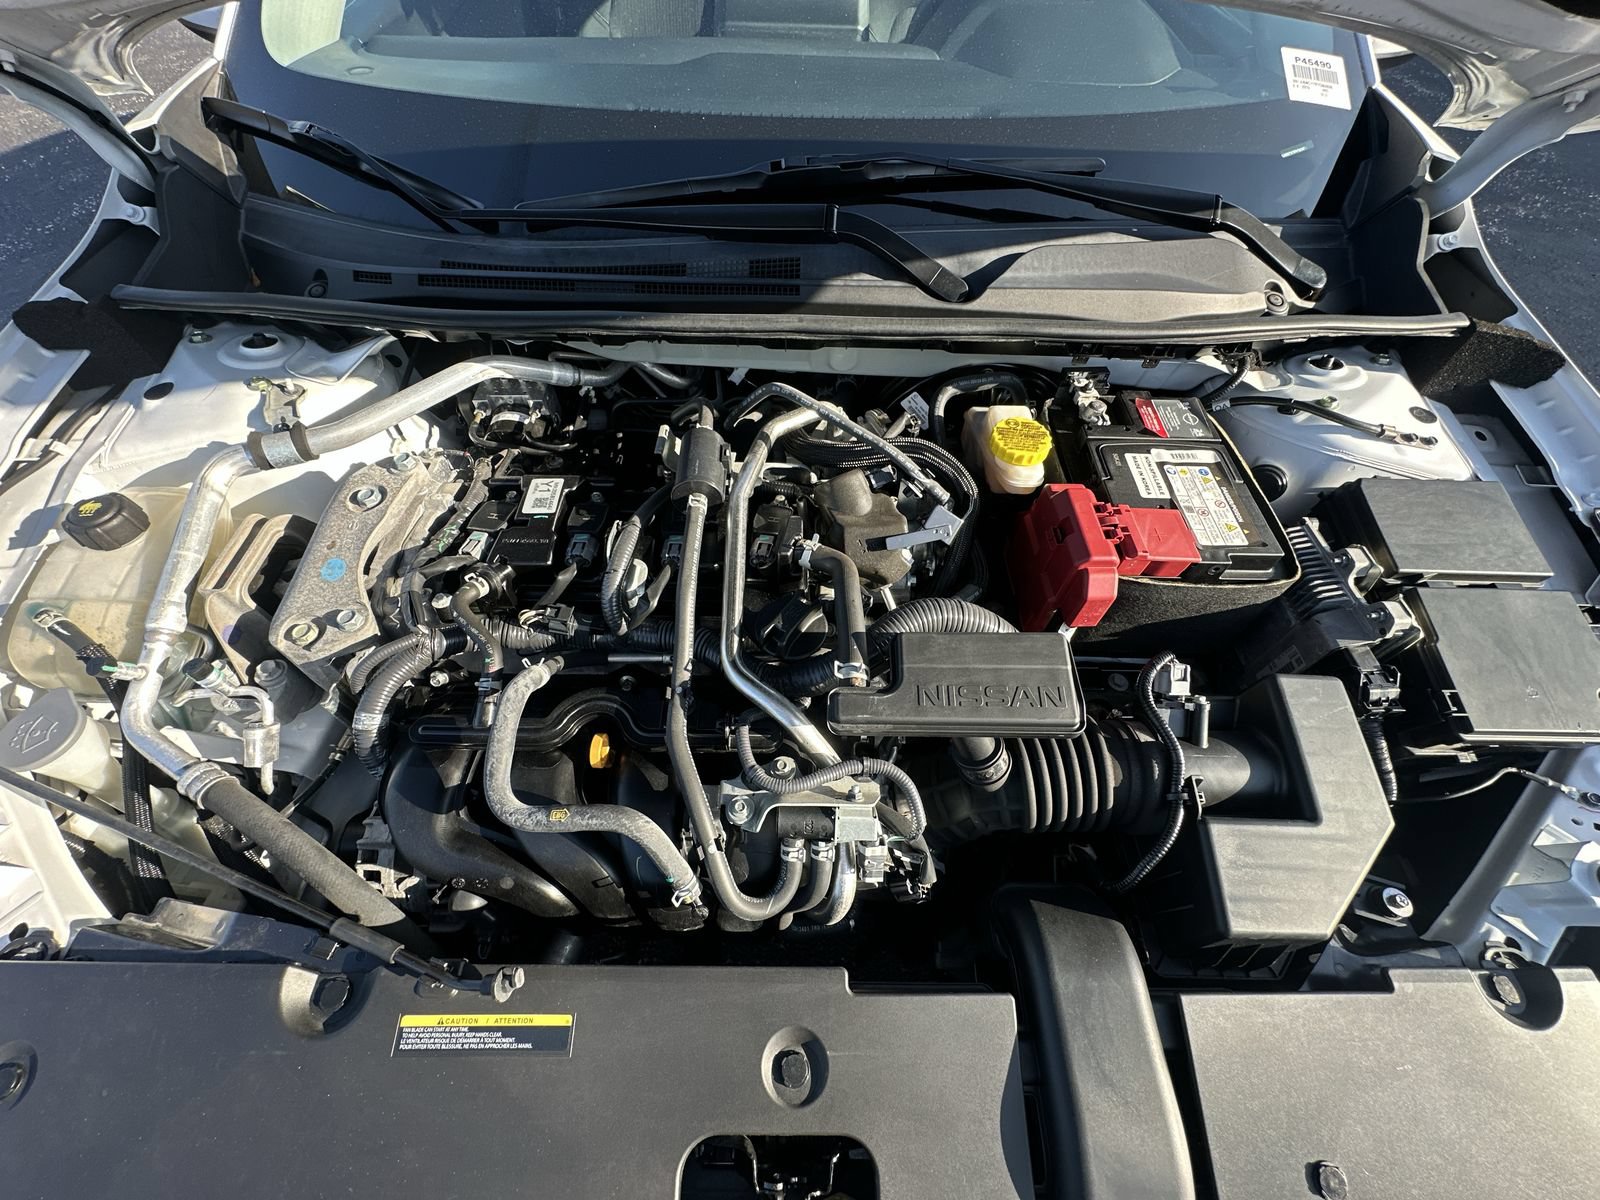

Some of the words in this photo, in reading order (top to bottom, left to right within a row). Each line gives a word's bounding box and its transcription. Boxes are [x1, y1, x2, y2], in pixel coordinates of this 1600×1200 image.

[1132, 456, 1142, 470] MADE
[1141, 478, 1152, 496] KOREA
[914, 684, 1069, 709] NISSAN
